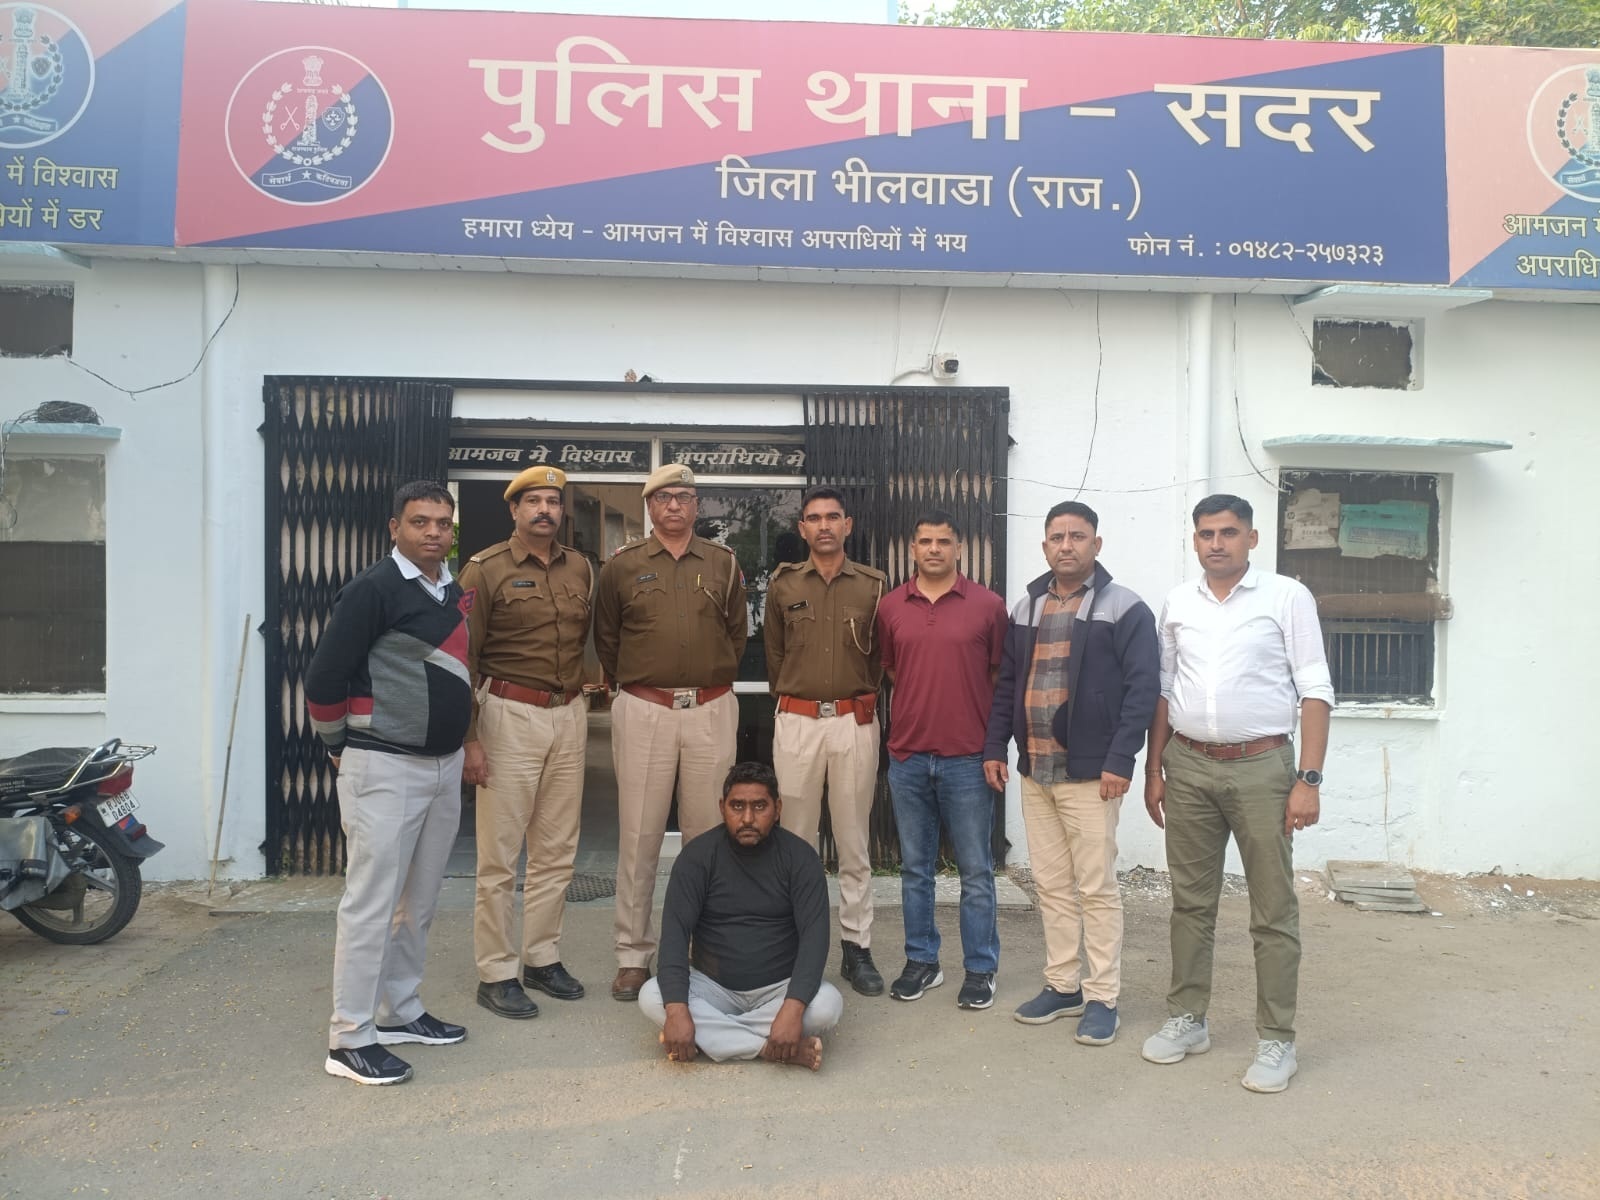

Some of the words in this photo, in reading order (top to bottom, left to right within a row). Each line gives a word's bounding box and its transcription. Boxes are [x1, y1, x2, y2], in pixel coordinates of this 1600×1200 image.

[469, 36, 762, 154] पुलिस
[805, 70, 1029, 141] थाना
[1154, 83, 1381, 153] सदर
[6, 155, 24, 186] में
[33, 156, 119, 189] विश्वास
[715, 154, 817, 202] जिला
[832, 157, 993, 207] भीलवाडा
[40, 198, 60, 229] में
[67, 208, 104, 230] डर
[1503, 213, 1587, 238] आमजन
[462, 217, 523, 240] हमारा
[530, 213, 575, 241] ध्येय
[603, 222, 684, 244] आमजन
[690, 219, 708, 245] में
[717, 219, 793, 248] विश्वास
[801, 224, 903, 251] अपराधियों
[909, 226, 927, 252] में
[935, 231, 968, 253] भय
[1128, 231, 1170, 256] फोन
[1228, 239, 1384, 267] ०१४८२-२५७३२३
[1516, 249, 1600, 278] अपराधि
[559, 444, 636, 464] विश्वास
